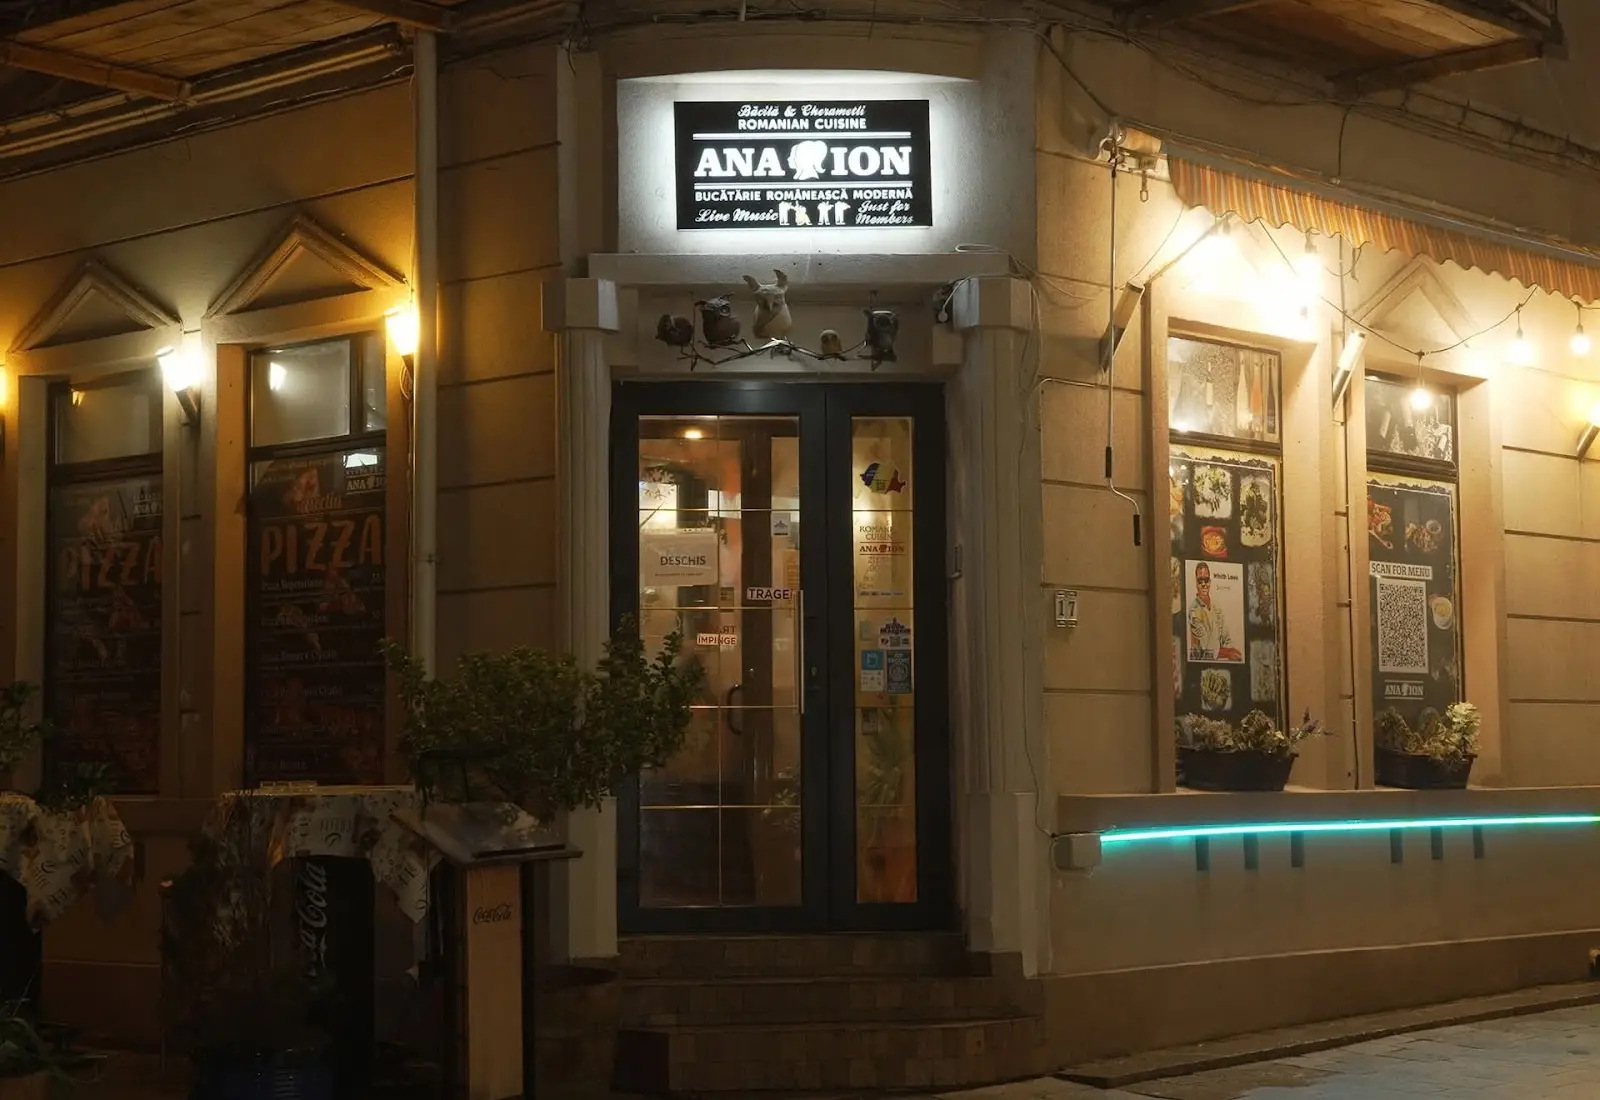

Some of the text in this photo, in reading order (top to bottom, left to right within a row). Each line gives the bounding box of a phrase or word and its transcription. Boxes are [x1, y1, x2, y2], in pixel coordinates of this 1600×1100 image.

[784, 104, 797, 117] &
[738, 117, 867, 130] ROMANIAN CUISINE
[693, 146, 913, 178] ANA ION
[695, 187, 914, 202] BUCĂTĂRIE ROMÂNEASCĂ MODERNĂ
[858, 201, 912, 214] Just for
[695, 207, 780, 223] Live Music
[855, 212, 914, 226] Members
[259, 511, 384, 576] PIZZA
[859, 545, 878, 553] ANA
[660, 555, 706, 567] DESCHIS
[1371, 563, 1430, 578] SCAN FOR MENU
[748, 588, 790, 600] TRAGE
[1058, 600, 1075, 617] 17
[698, 636, 736, 645] IMPINGE
[1384, 684, 1424, 696] ANA ION
